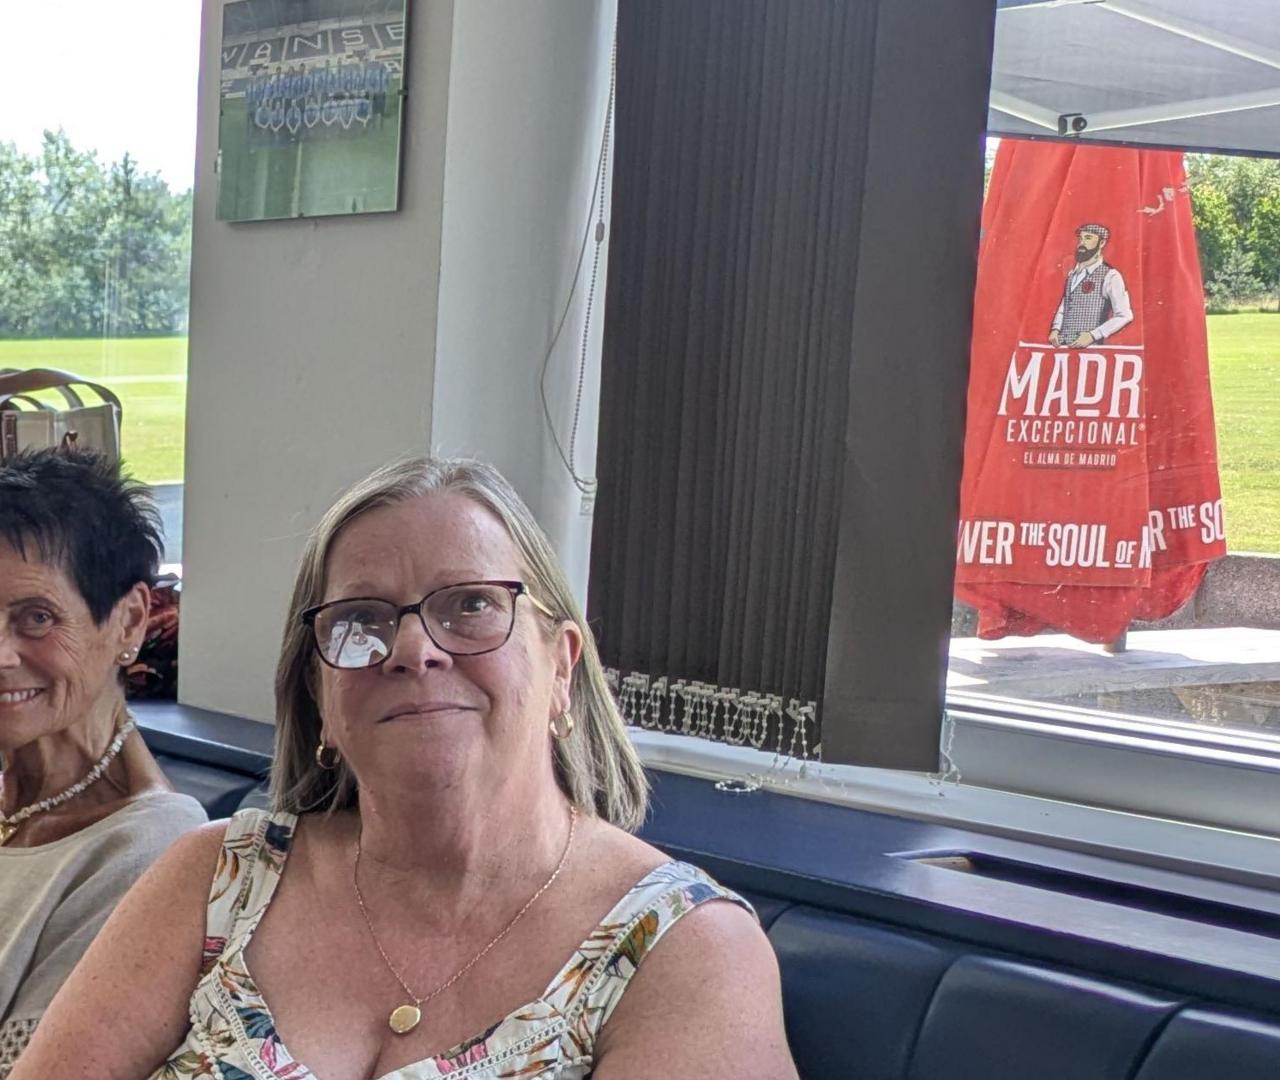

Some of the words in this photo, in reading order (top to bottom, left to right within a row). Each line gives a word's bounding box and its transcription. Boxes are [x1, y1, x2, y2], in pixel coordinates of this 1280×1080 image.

[1006, 419, 1139, 445] EXCEPCIONAL
[1023, 451, 1034, 465] EL
[1037, 451, 1060, 465] ALMA
[1064, 452, 1074, 465] DE
[1078, 453, 1117, 467] MADRID
[1168, 504, 1196, 531] THE
[1020, 522, 1045, 547] THE
[1045, 523, 1110, 568] SOUL
[1114, 540, 1137, 569] OF
